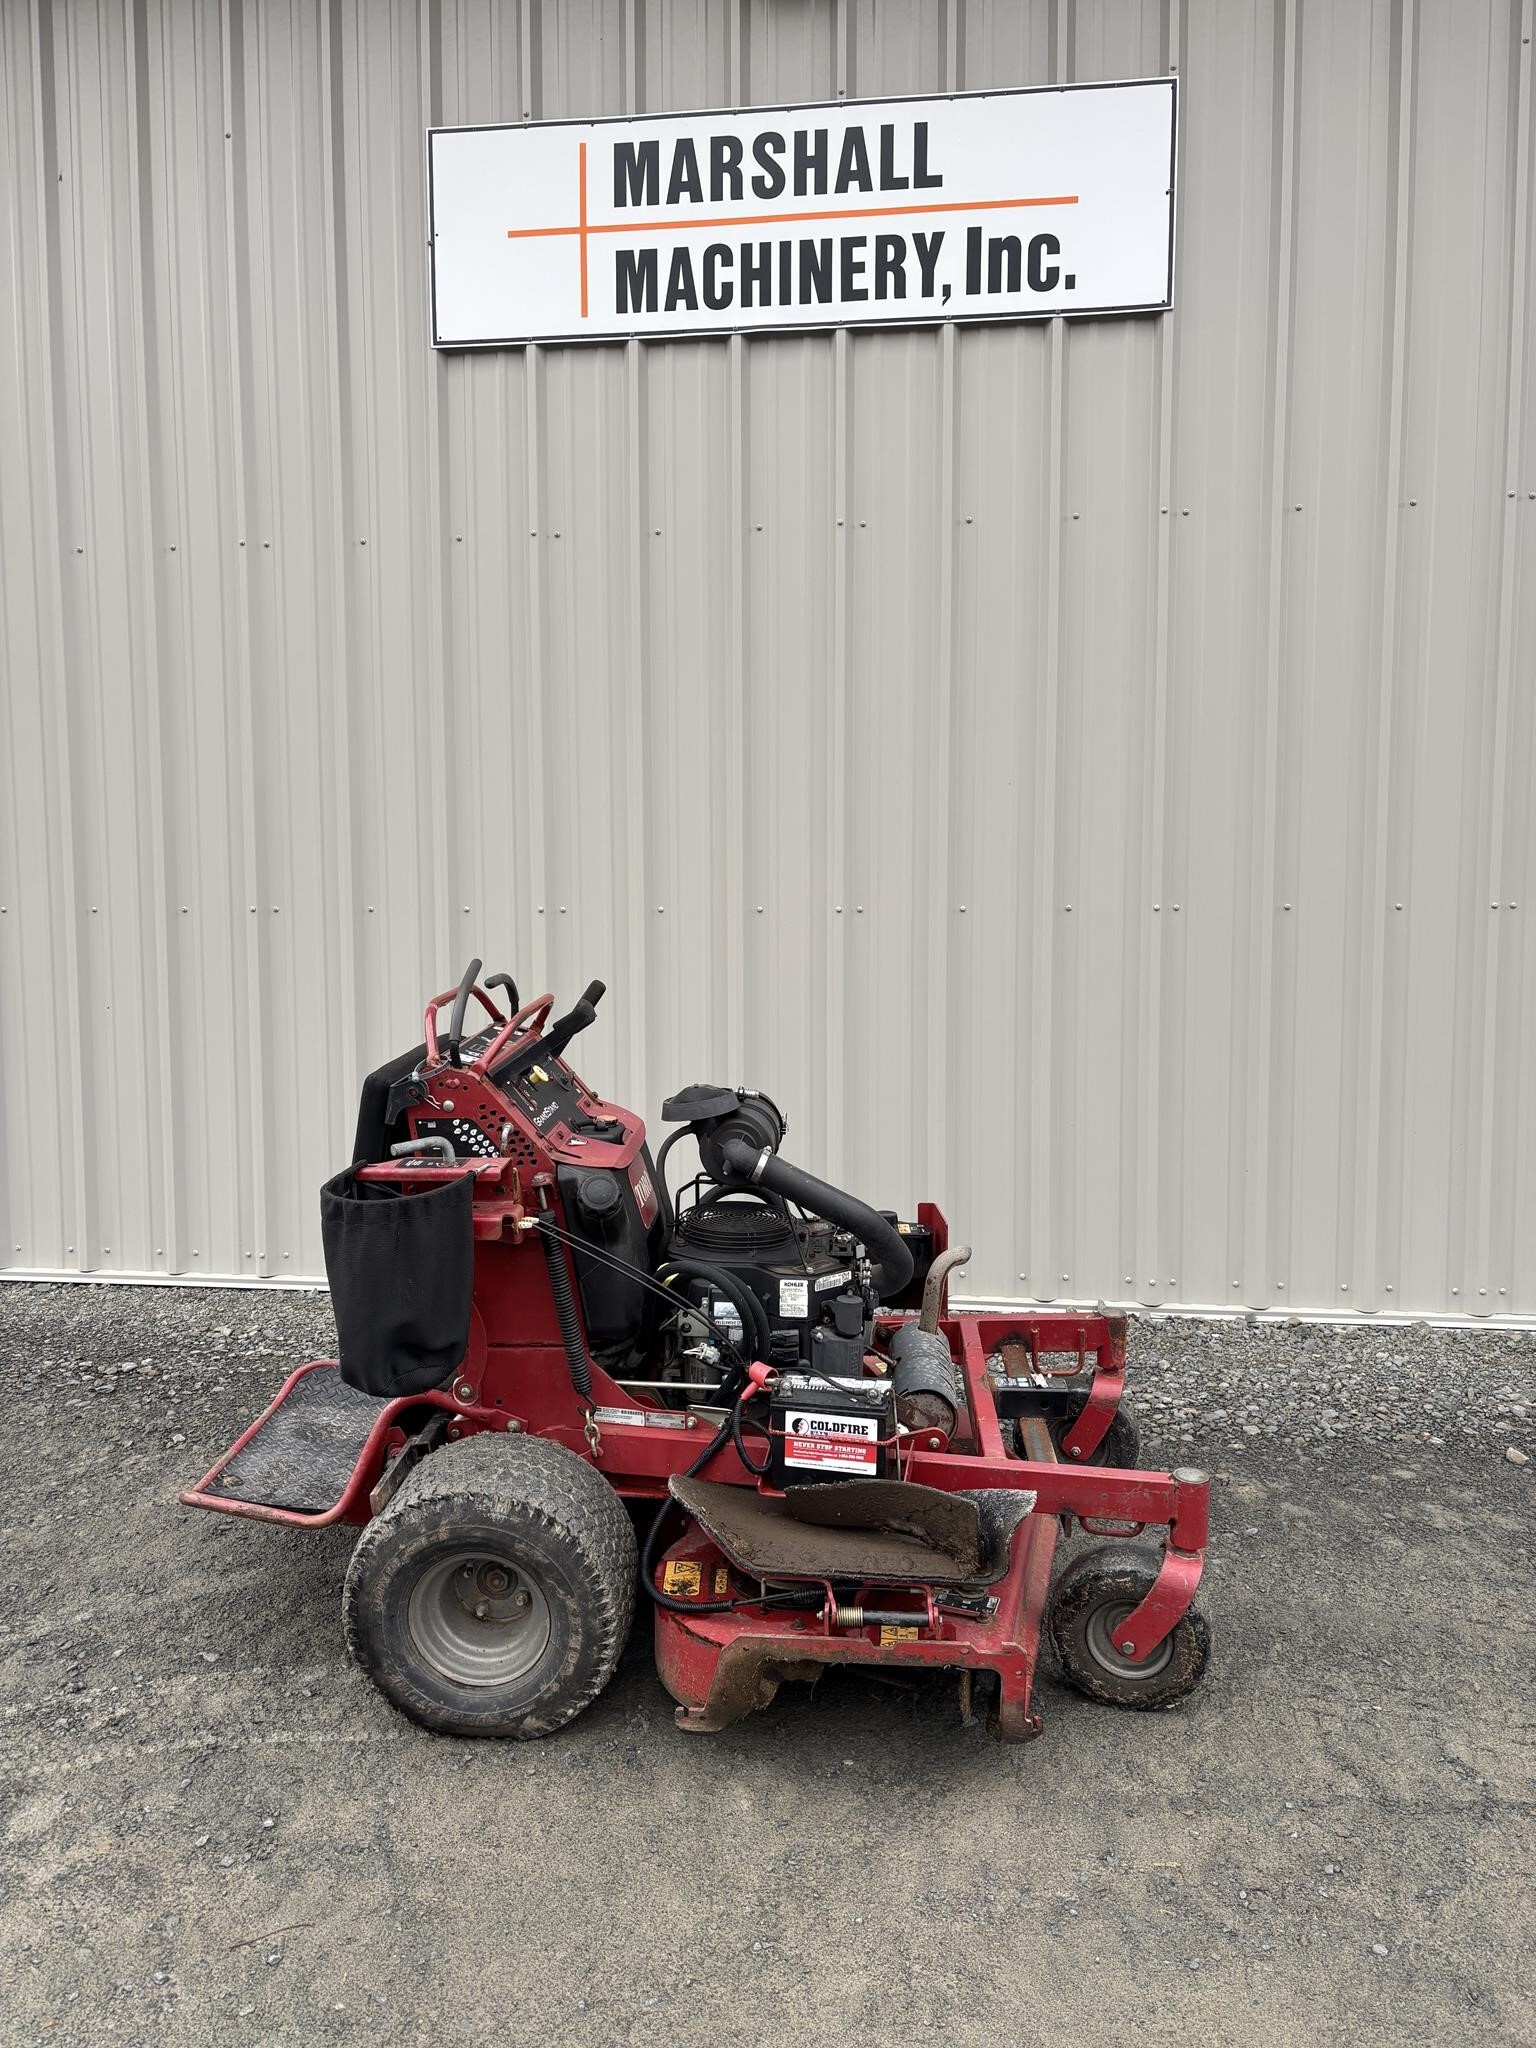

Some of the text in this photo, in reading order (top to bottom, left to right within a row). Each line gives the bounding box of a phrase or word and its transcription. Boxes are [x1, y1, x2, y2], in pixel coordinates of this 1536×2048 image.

[613, 121, 943, 208] MARSHALL
[615, 226, 1076, 313] MACHINERY, Inc.
[793, 1441, 815, 1450] NEVER
[816, 1443, 833, 1451] STOP
[834, 1445, 867, 1455] STARTING
[810, 1420, 869, 1436] COLDFIRE
